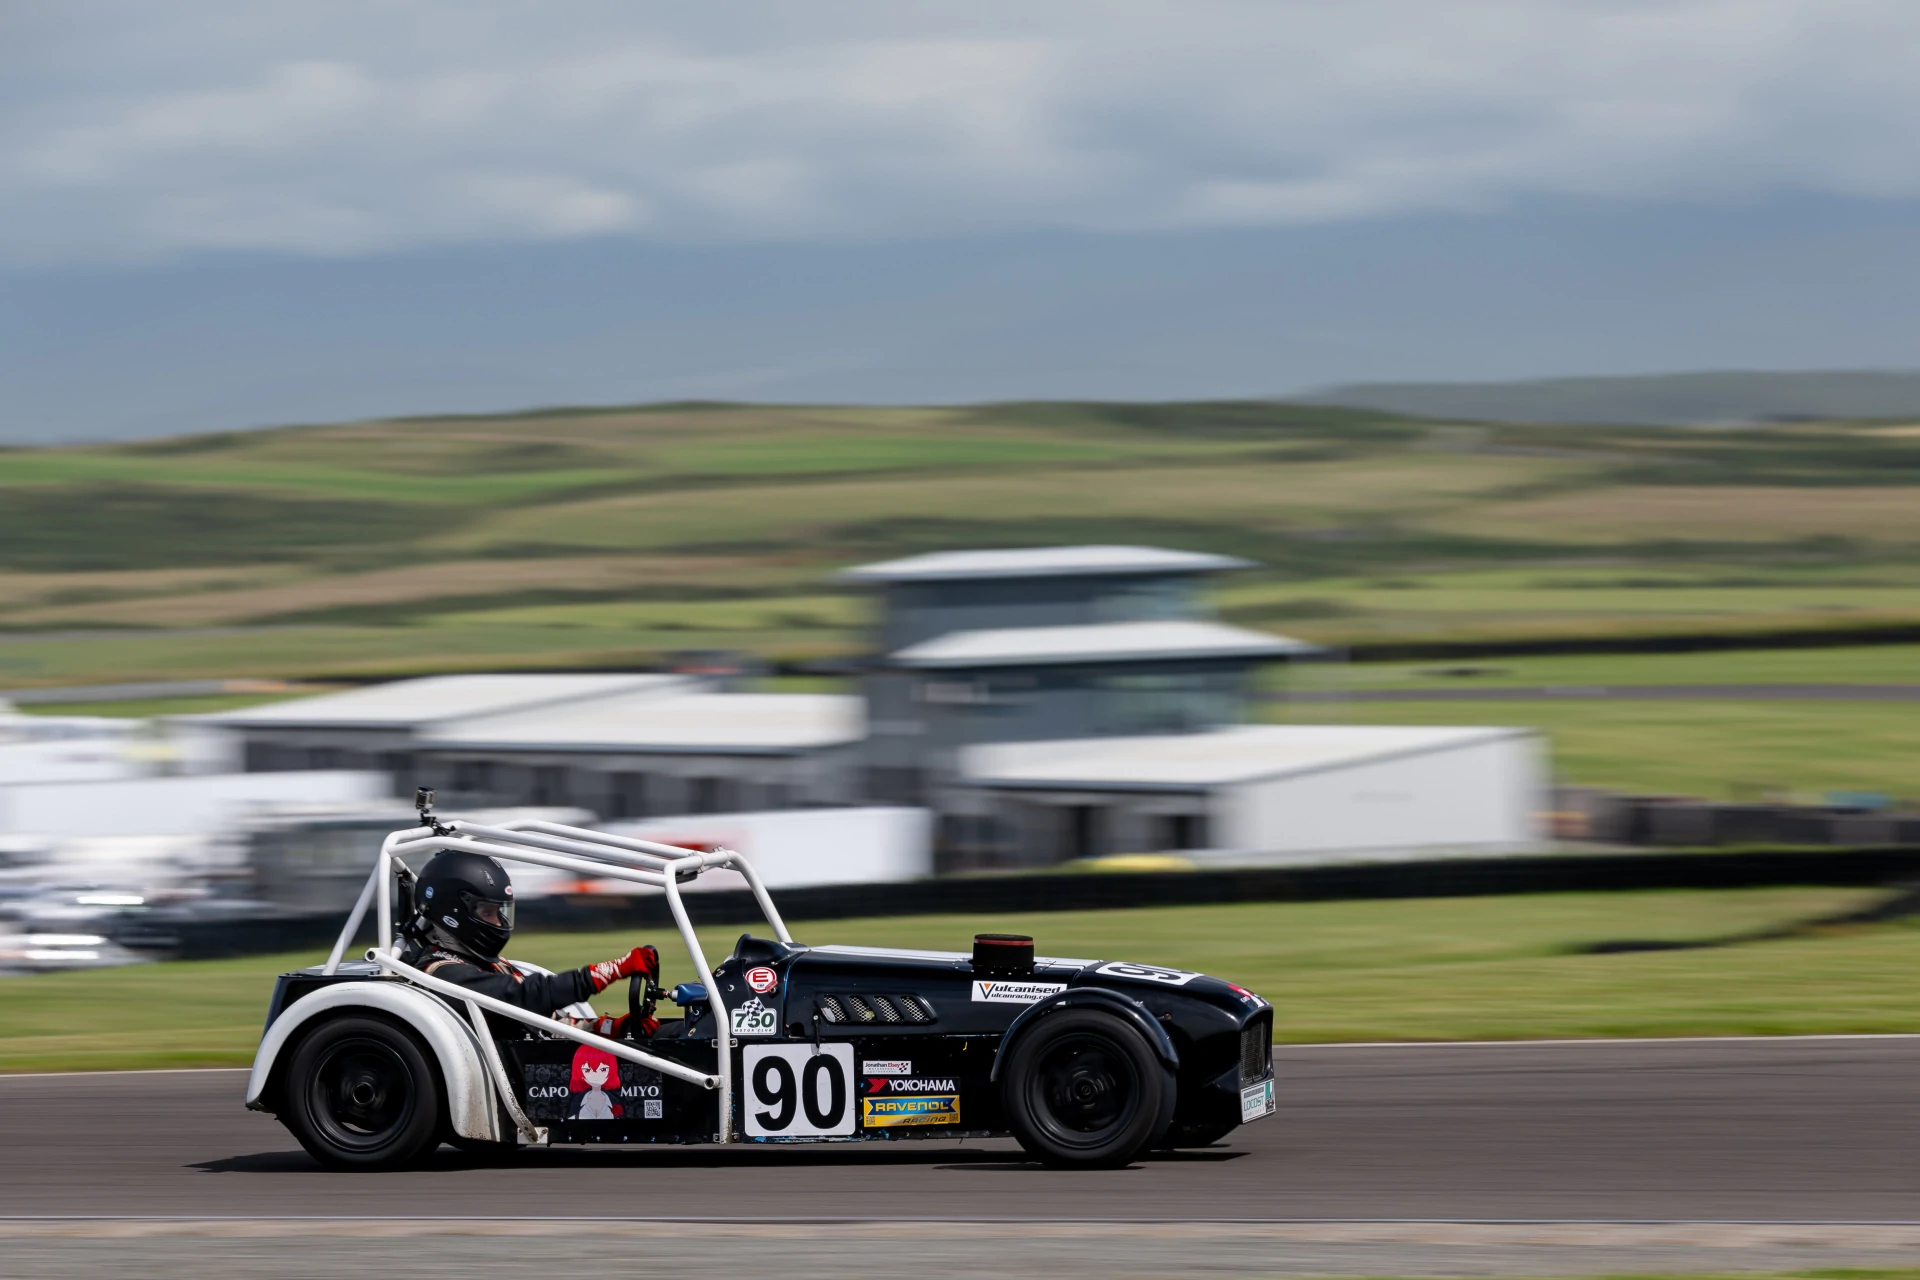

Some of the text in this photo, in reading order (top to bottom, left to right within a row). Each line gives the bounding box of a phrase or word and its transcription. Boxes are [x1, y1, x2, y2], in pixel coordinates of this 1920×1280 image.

[735, 1012, 775, 1029] 750
[528, 1085, 660, 1098] CAPO MIYO
[888, 1079, 956, 1092] YOKOHAMA
[752, 1053, 847, 1132] 90
[875, 1101, 949, 1113] RAVENOL
[902, 1116, 947, 1125] RACING
